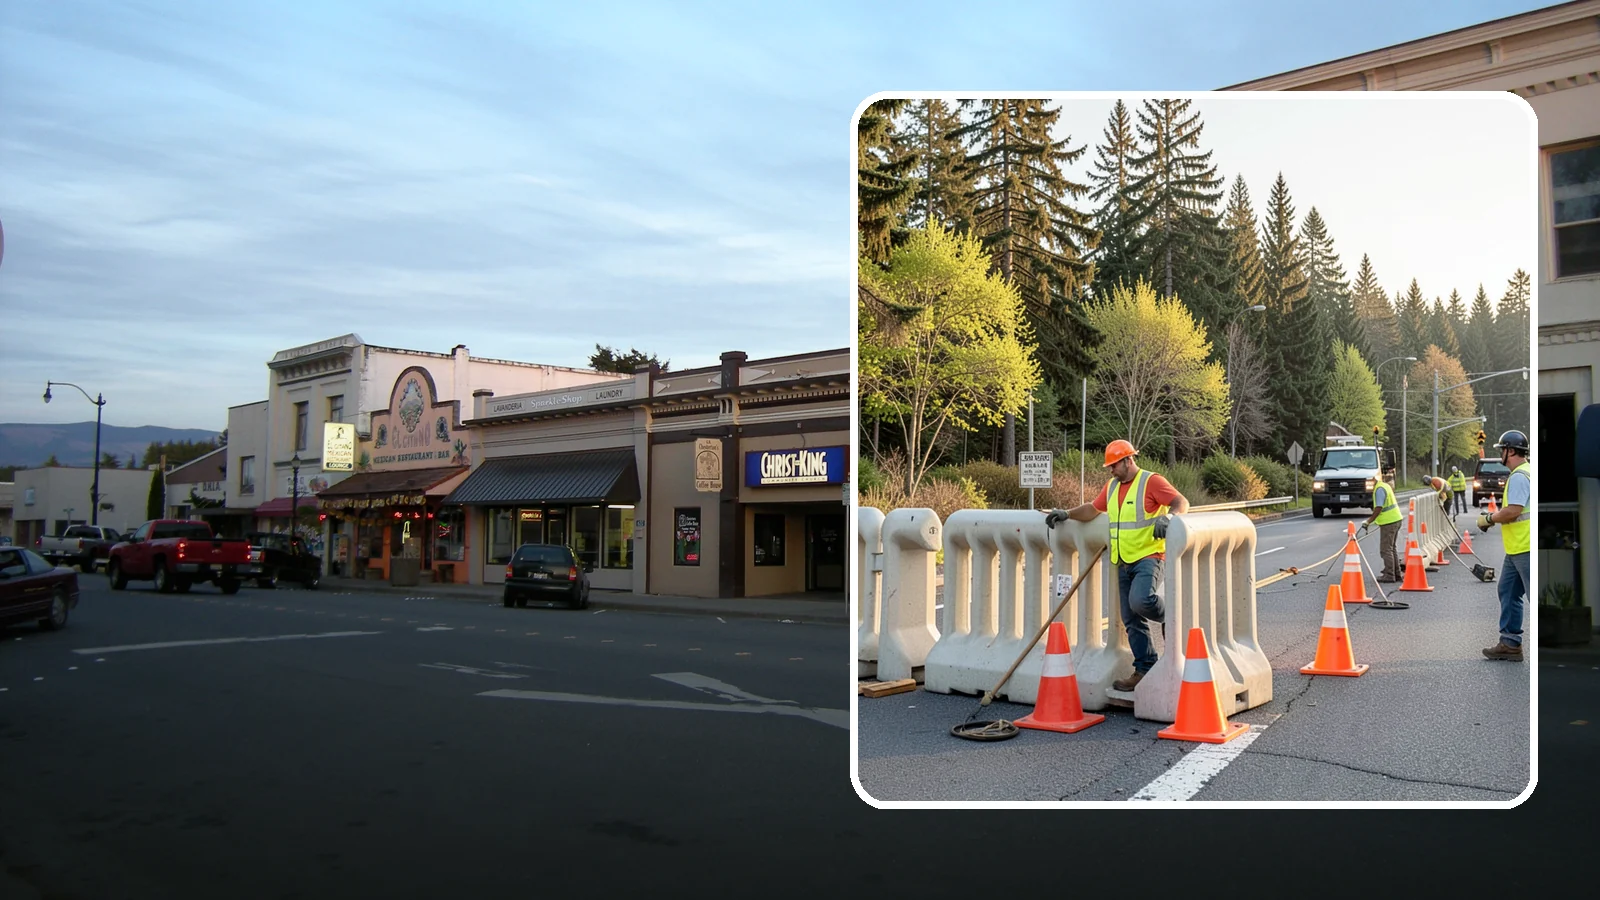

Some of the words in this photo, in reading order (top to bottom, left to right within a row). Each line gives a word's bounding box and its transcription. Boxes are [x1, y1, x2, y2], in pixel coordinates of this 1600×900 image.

[595, 388, 623, 400] LAUNDRY
[493, 402, 522, 413] LAVANDERIA
[374, 455, 396, 464] MEXICAN
[397, 451, 434, 463] RESTAURANT
[438, 450, 450, 459] BAR
[760, 452, 797, 478] CHRIST
[799, 449, 827, 476] KING
